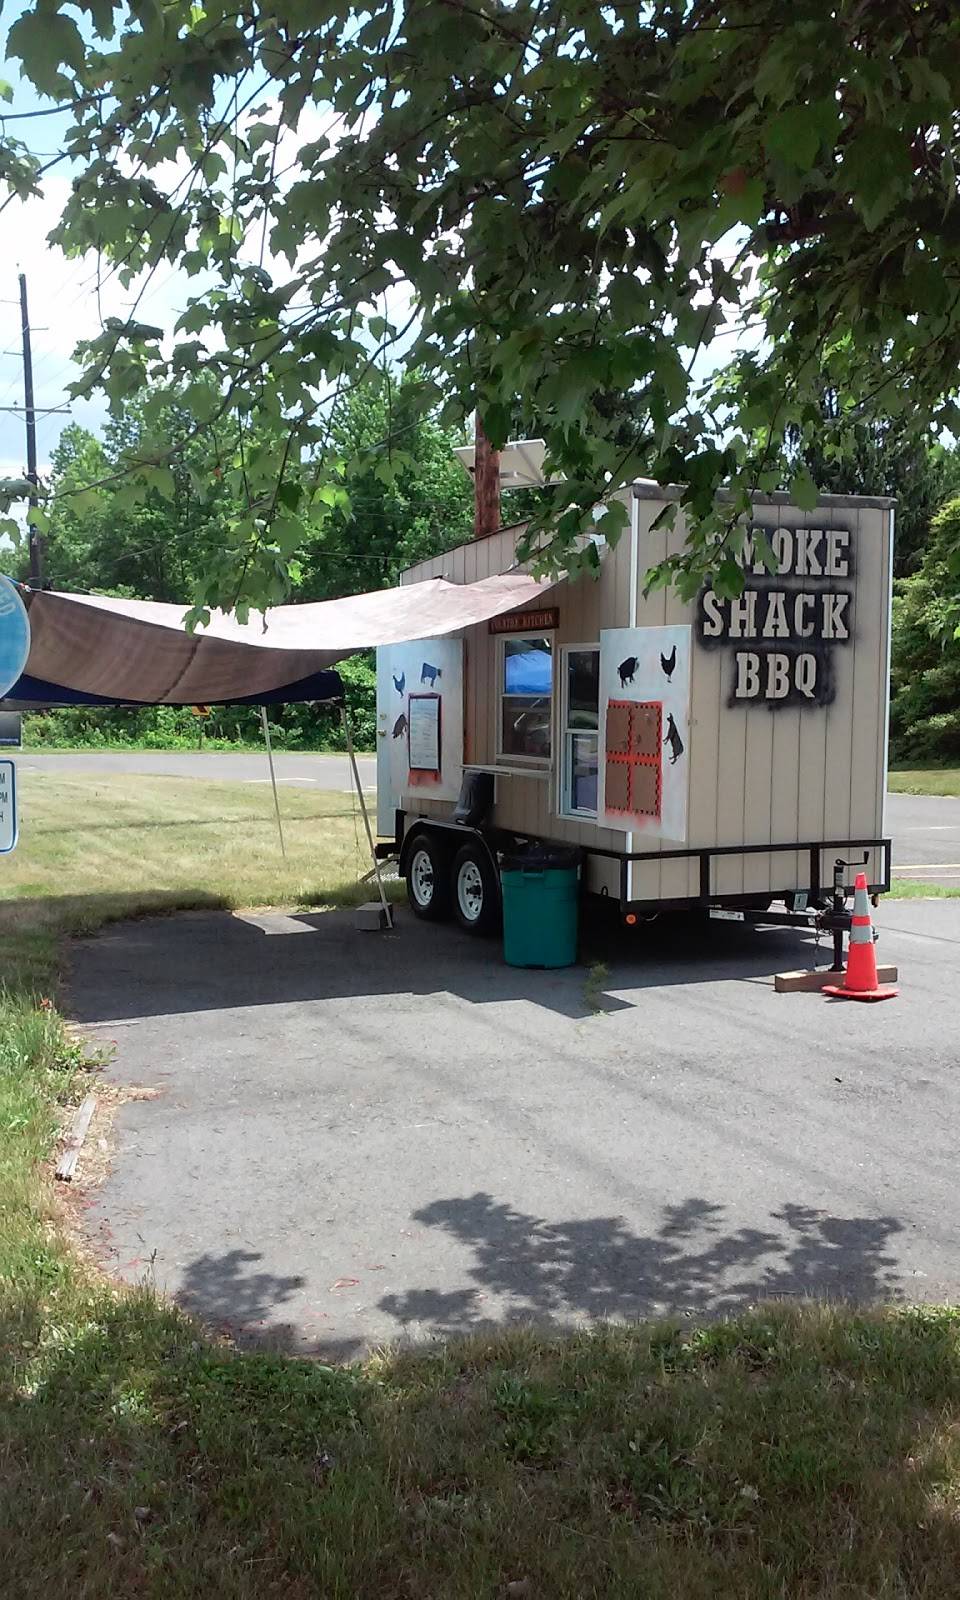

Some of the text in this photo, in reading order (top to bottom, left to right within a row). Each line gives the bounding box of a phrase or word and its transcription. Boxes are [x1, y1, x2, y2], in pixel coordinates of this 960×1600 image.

[712, 528, 849, 576] MOKE
[703, 590, 849, 639] SHACK
[735, 652, 817, 698] BBQ
